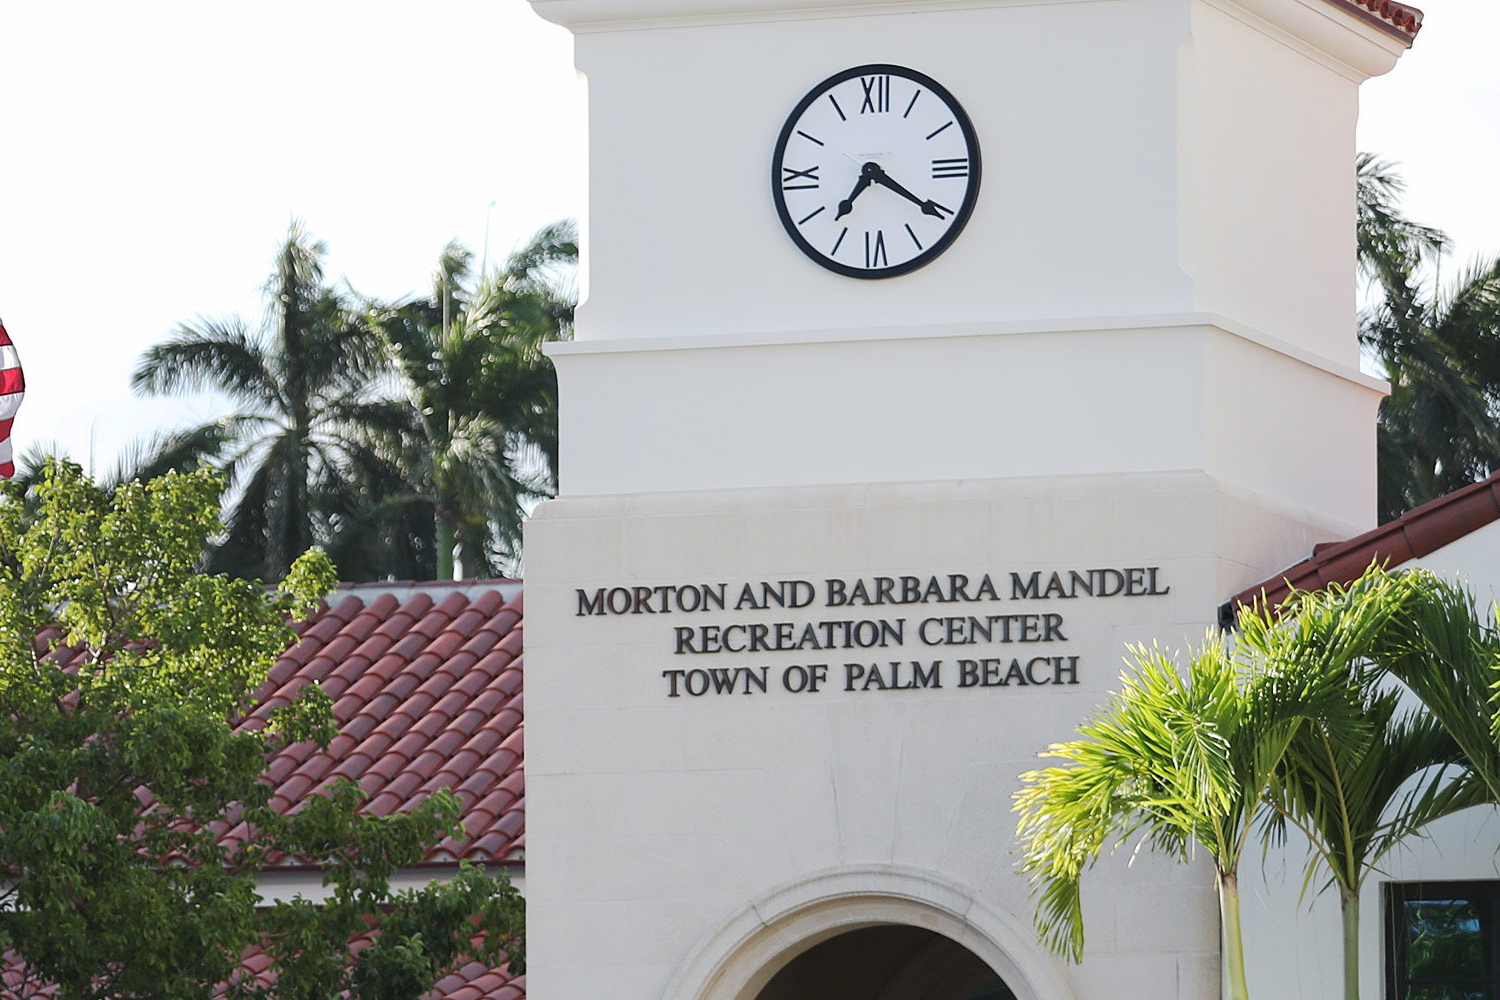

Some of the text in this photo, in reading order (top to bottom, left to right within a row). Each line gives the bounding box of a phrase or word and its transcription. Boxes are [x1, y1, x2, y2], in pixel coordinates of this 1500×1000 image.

[860, 75, 890, 114] XII
[576, 567, 1170, 616] MORTON AND BARBARA MANDEL
[674, 613, 1069, 654] RECREATION CENTER
[662, 656, 1081, 697] TOWN OF PALM BEACH
